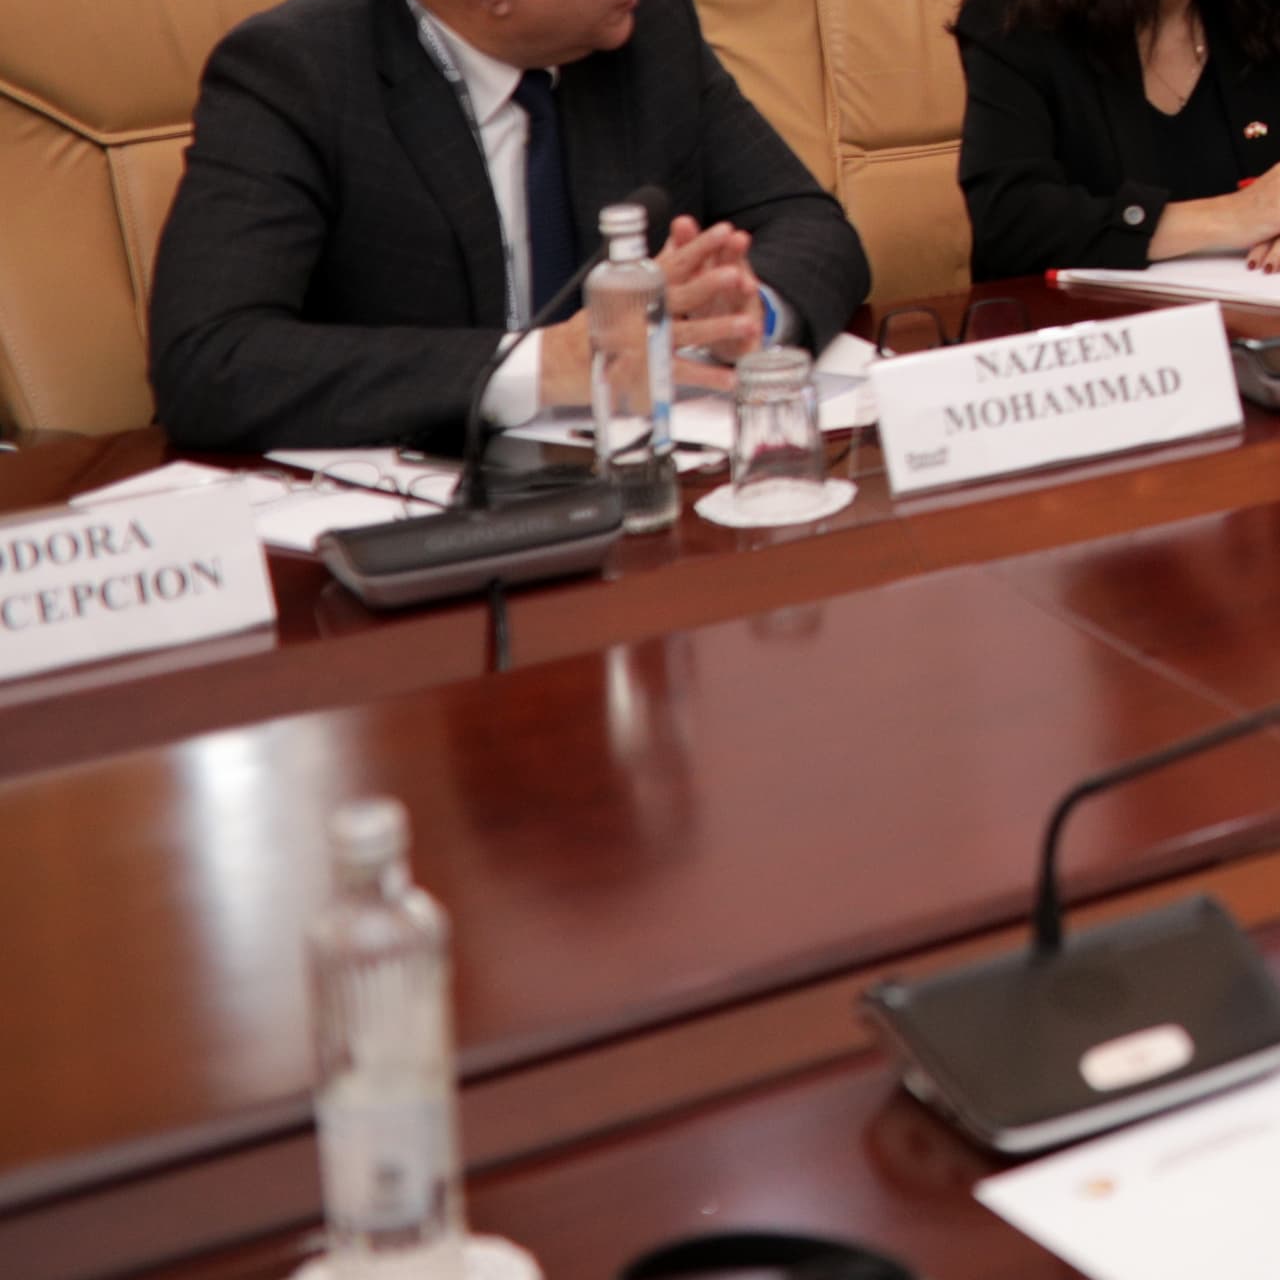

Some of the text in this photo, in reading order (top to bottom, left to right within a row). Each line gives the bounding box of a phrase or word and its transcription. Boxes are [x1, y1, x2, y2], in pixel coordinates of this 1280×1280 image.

[974, 329, 1134, 383] NAZEEM
[943, 366, 1181, 435] MOHAMMAD
[0, 519, 153, 573] DORA
[0, 557, 224, 631] CEPCION
